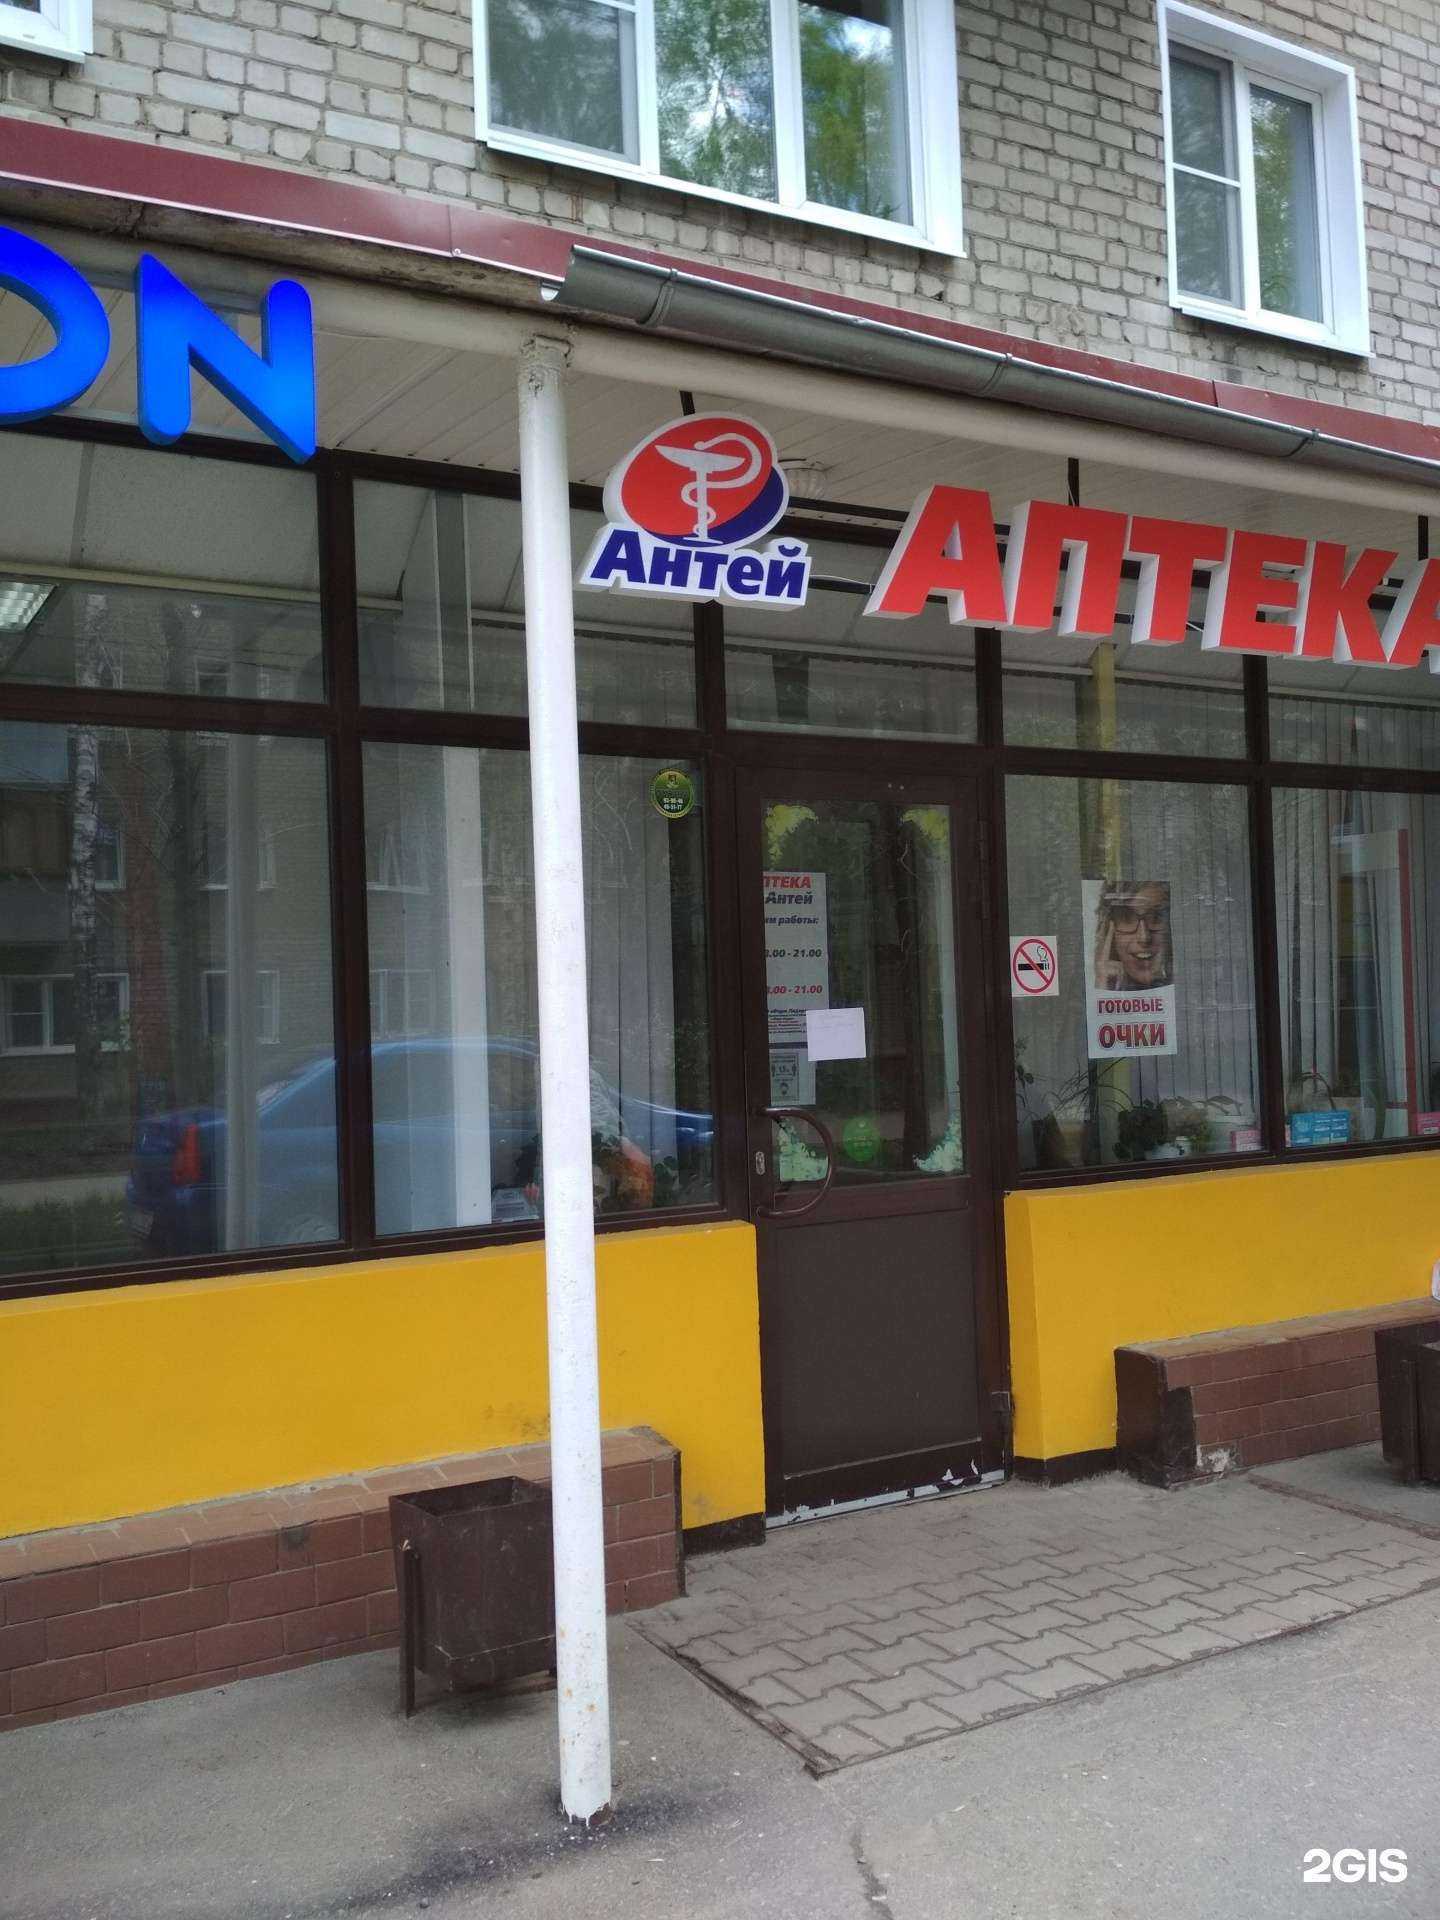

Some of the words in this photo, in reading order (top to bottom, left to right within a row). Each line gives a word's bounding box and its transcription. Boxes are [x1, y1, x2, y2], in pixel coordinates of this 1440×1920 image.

[590, 529, 806, 599] Антей
[765, 891, 813, 905] Антей
[778, 915, 819, 926] работы:
[793, 948, 822, 958] 21.00
[767, 985, 787, 995] .00
[794, 985, 823, 995] 21.00
[1098, 998, 1164, 1014] ГОТОВЫЕ
[1099, 1022, 1166, 1049] ОЧКИ
